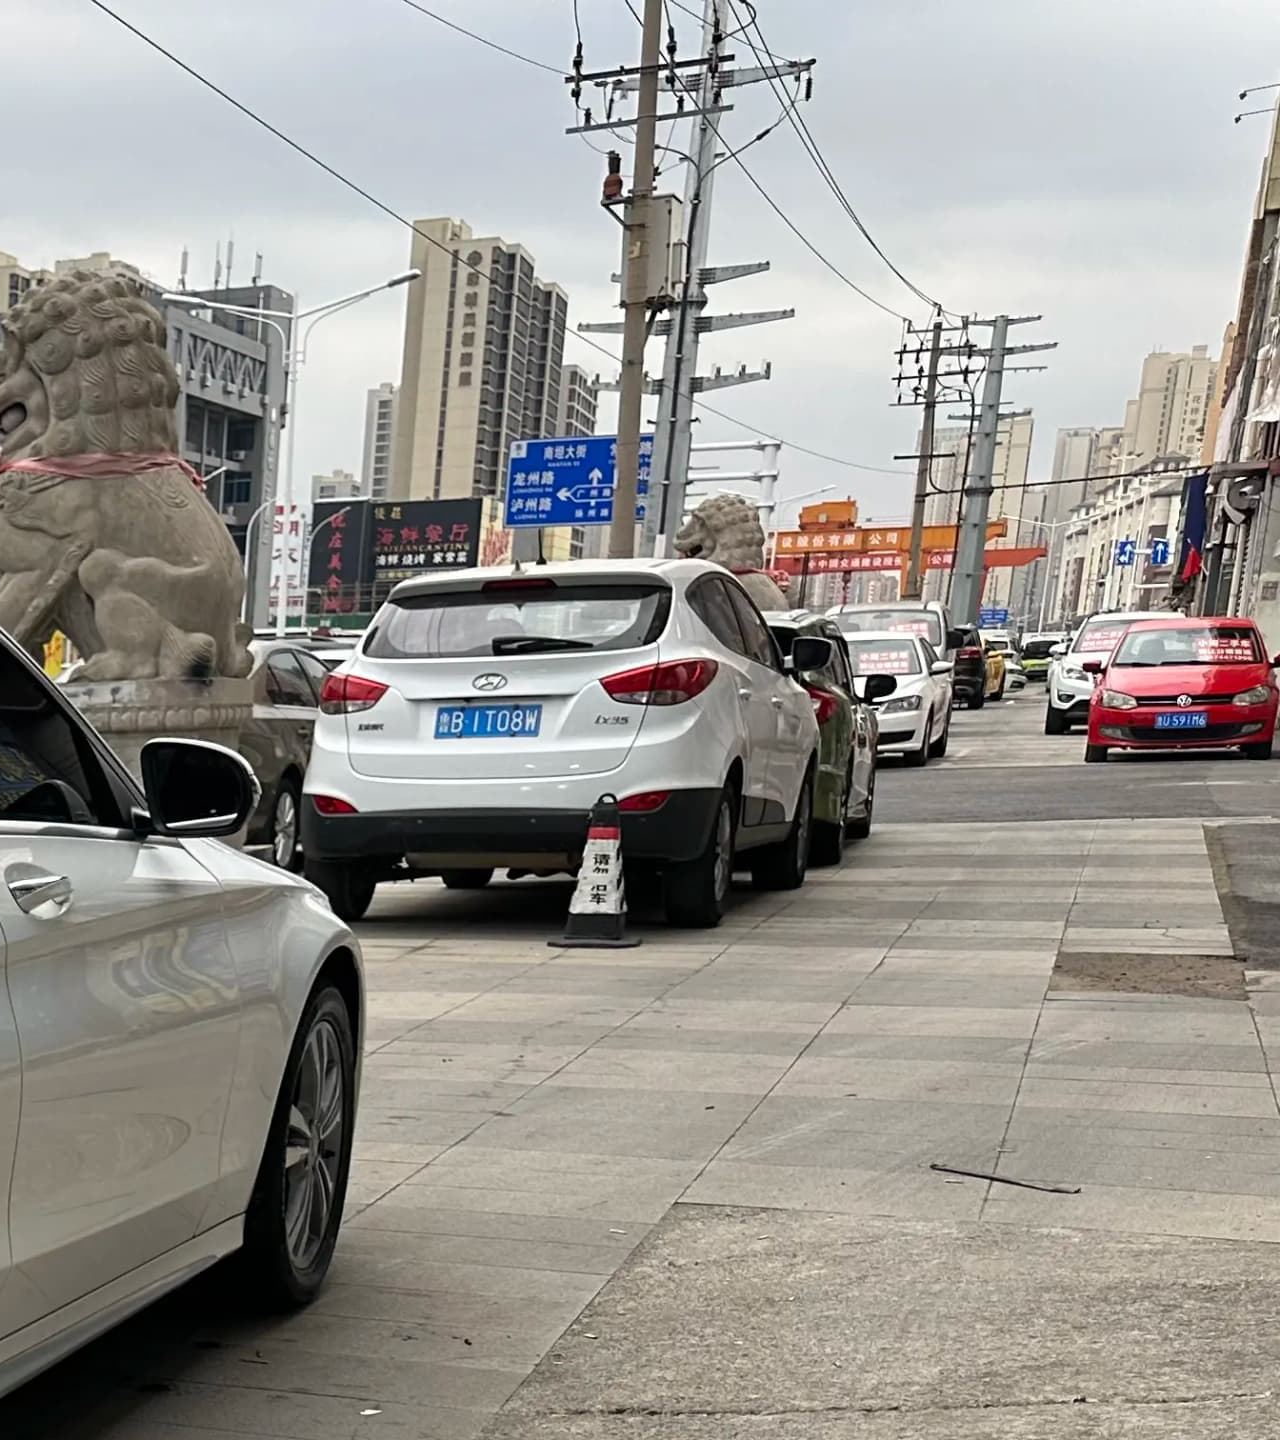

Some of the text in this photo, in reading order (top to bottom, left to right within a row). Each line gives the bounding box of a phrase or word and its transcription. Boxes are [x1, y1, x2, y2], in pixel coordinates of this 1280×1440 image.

[513, 470, 554, 486] 龙州路
[510, 497, 552, 512] 泸州路
